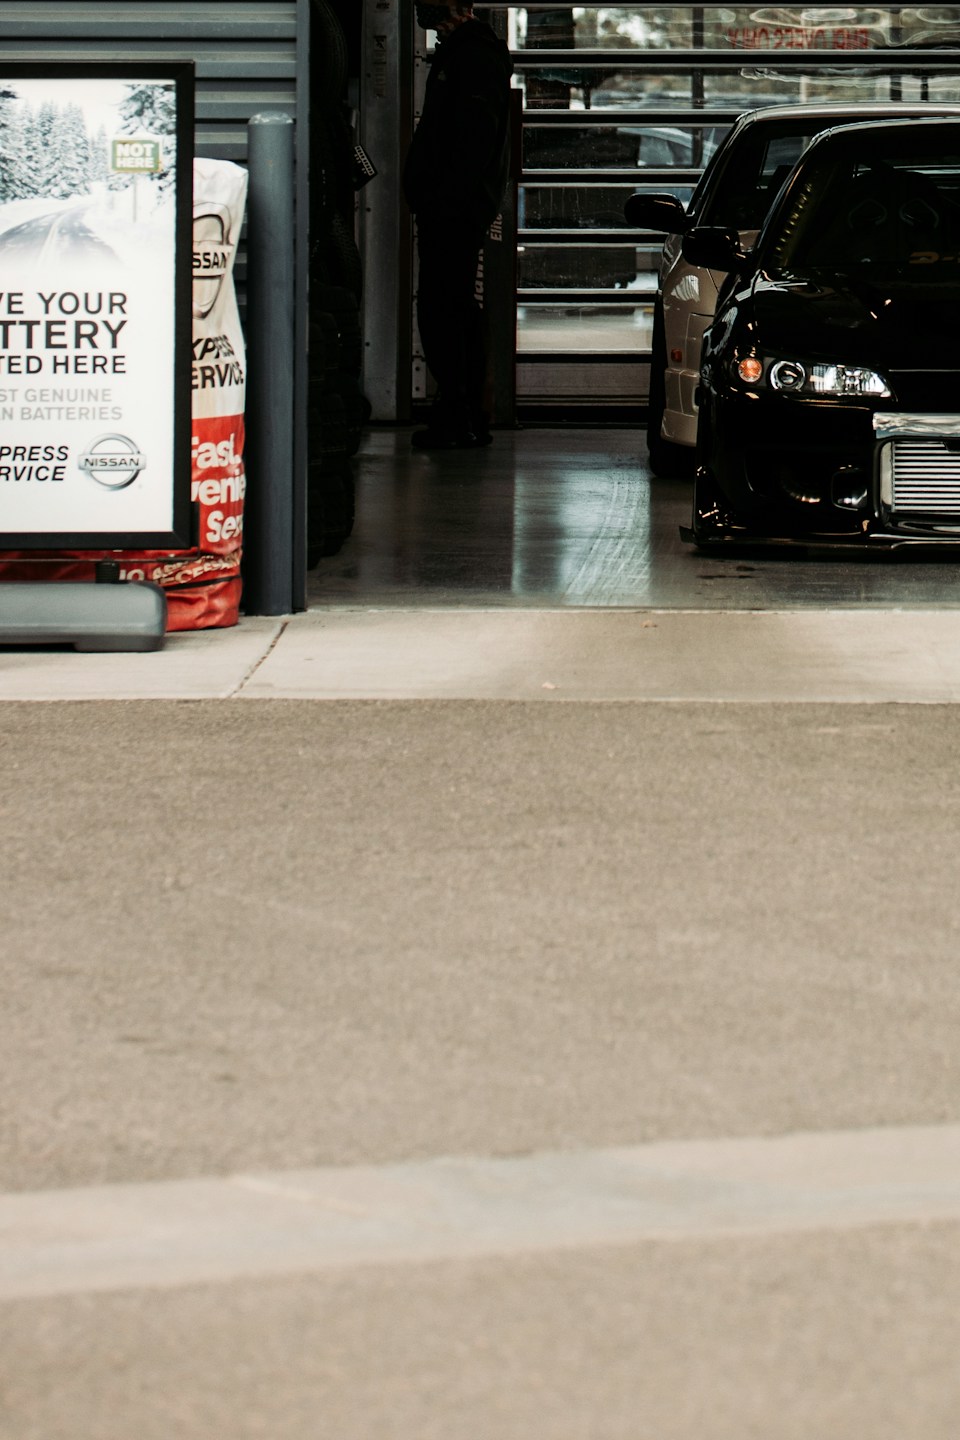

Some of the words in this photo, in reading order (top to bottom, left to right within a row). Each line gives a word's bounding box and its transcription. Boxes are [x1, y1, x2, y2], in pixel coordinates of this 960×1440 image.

[116, 143, 155, 157] NOT
[116, 157, 155, 169] HERE
[0, 292, 24, 314] E
[37, 292, 128, 315] YOUR
[0, 320, 128, 349] TTERY
[53, 355, 127, 375] HERE
[24, 388, 113, 403] GENUINE
[20, 406, 123, 421] BATTERIES
[0, 445, 69, 461] PRESS
[84, 457, 140, 468] NISSAN
